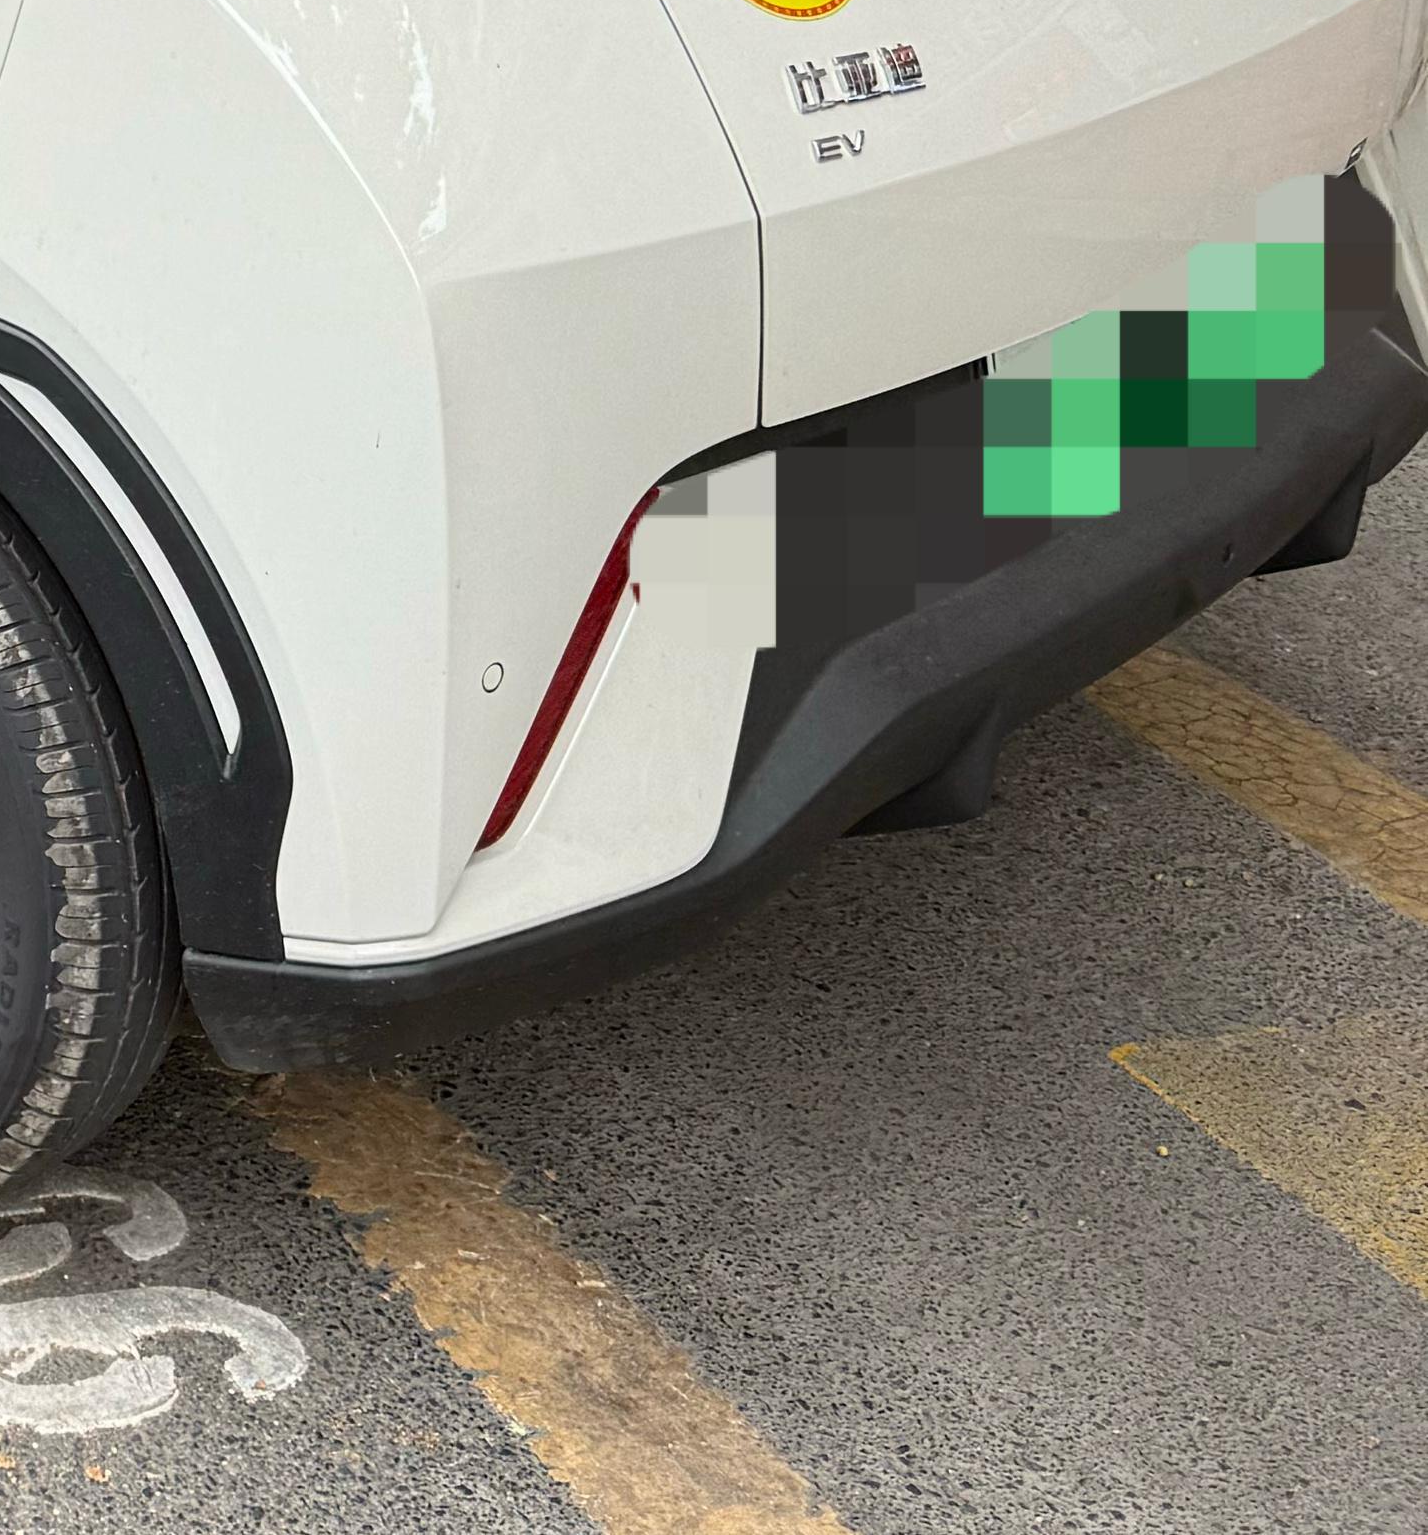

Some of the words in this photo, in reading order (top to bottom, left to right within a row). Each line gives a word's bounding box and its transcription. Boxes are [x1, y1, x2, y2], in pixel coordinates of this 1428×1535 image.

[785, 42, 927, 115] 比亚迪
[811, 128, 866, 164] EV
